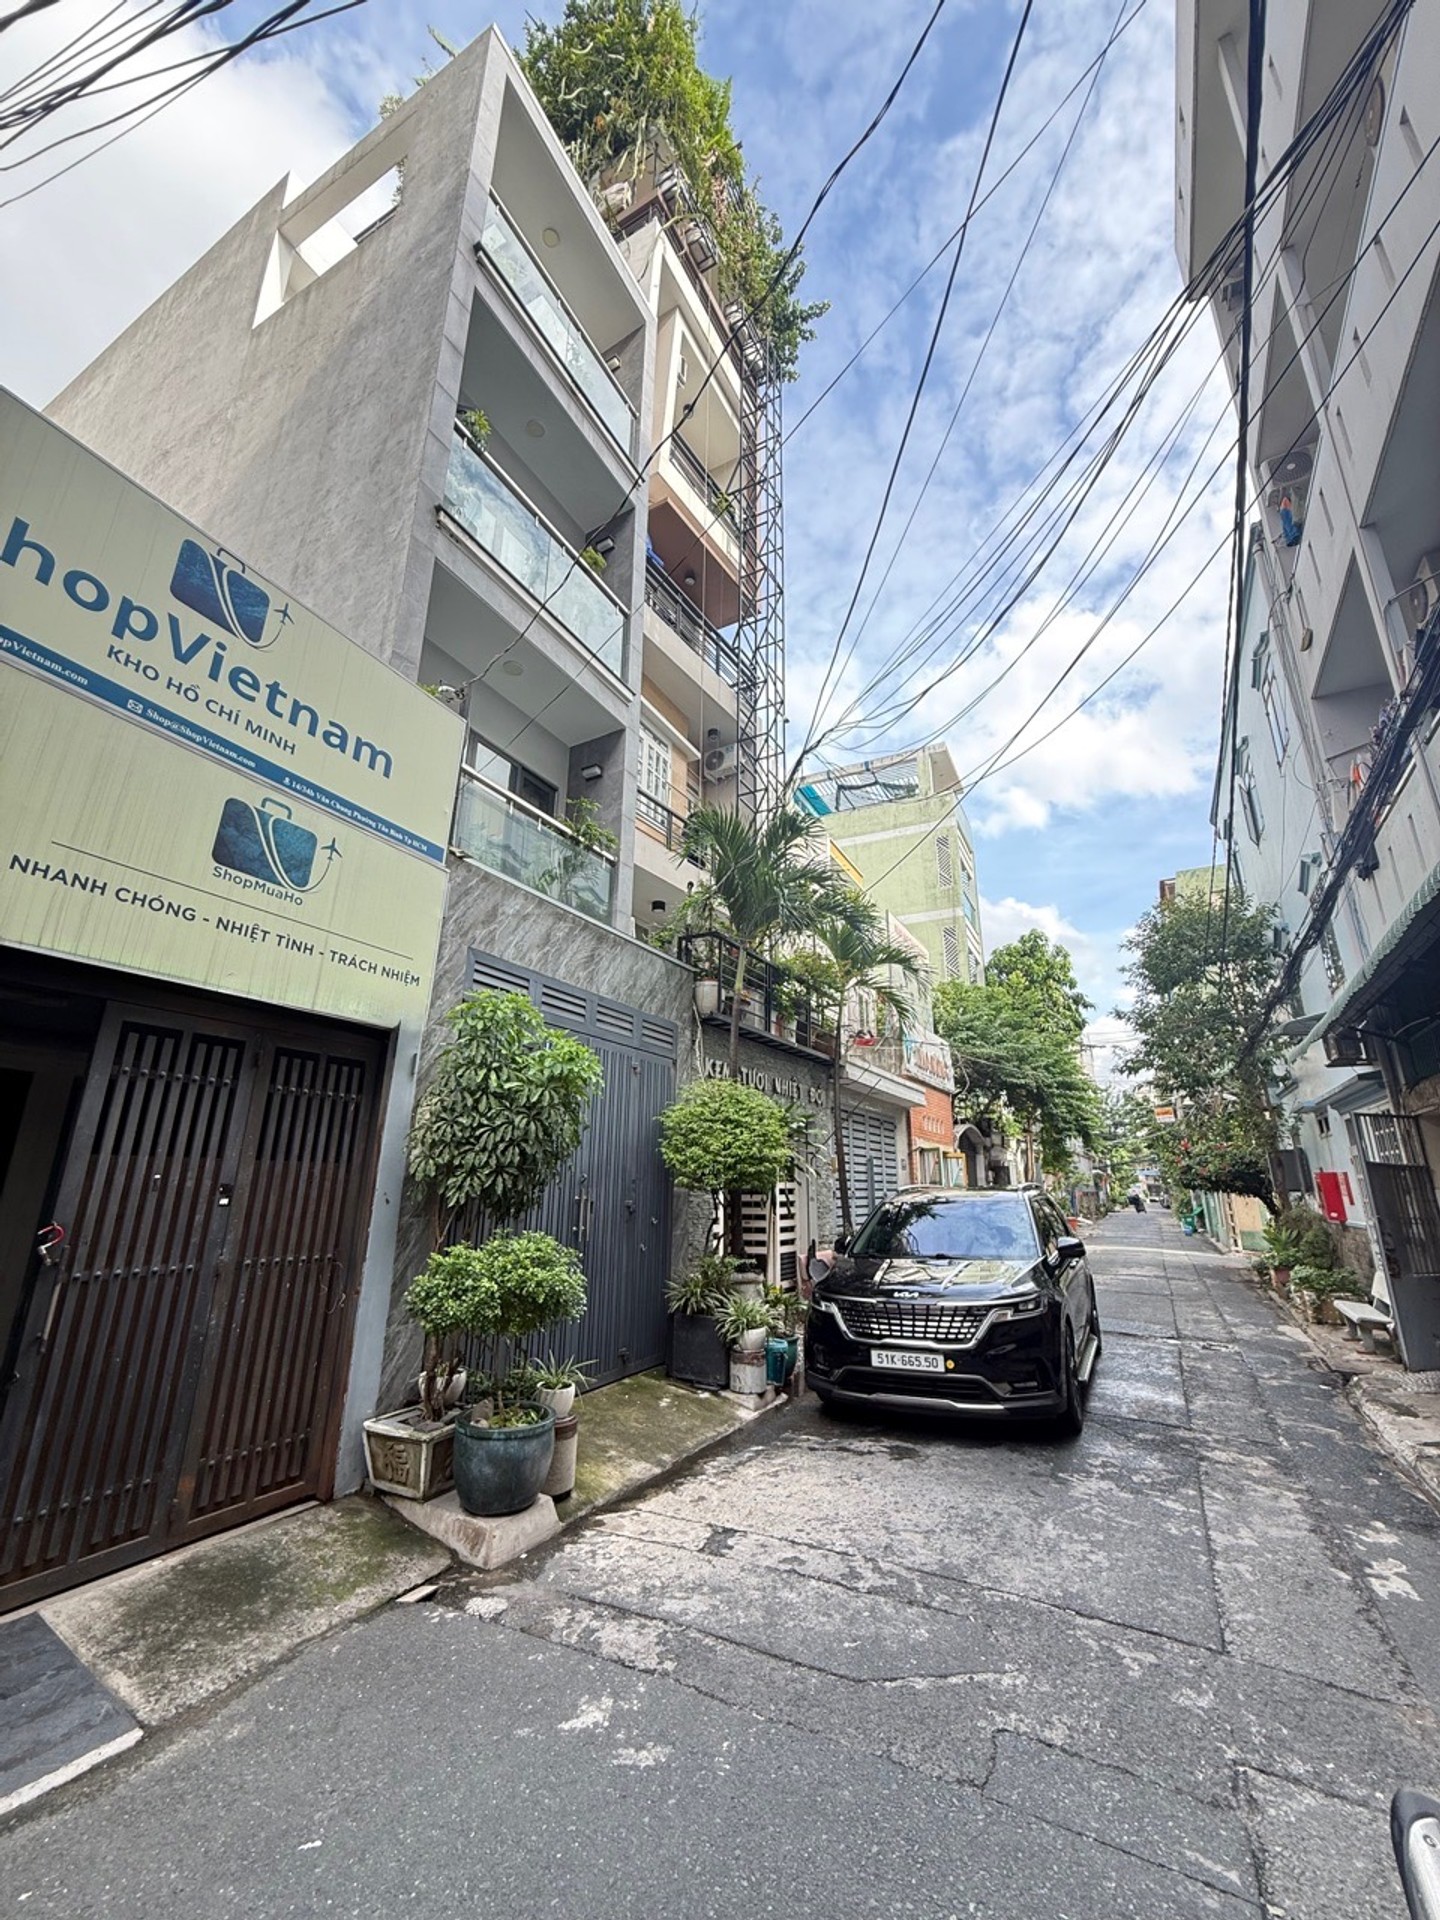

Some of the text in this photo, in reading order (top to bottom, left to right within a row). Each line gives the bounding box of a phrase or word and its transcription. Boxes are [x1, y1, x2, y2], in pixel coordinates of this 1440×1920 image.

[0, 517, 394, 779] hopVietnam
[107, 644, 297, 755] KHO HỒ CHÍ MINH
[146, 708, 257, 768] Shop@ShopVietnam.com
[9, 854, 108, 896] NHANH
[115, 887, 197, 922] CHÓNG
[215, 916, 270, 943] NHIỆT
[276, 933, 315, 956] TÌNH
[329, 950, 378, 975] TRÁCH
[381, 966, 420, 987] NHIỆM
[212, 865, 303, 906] ShopMuaHo
[877, 1353, 938, 1369] 51K-665.50
